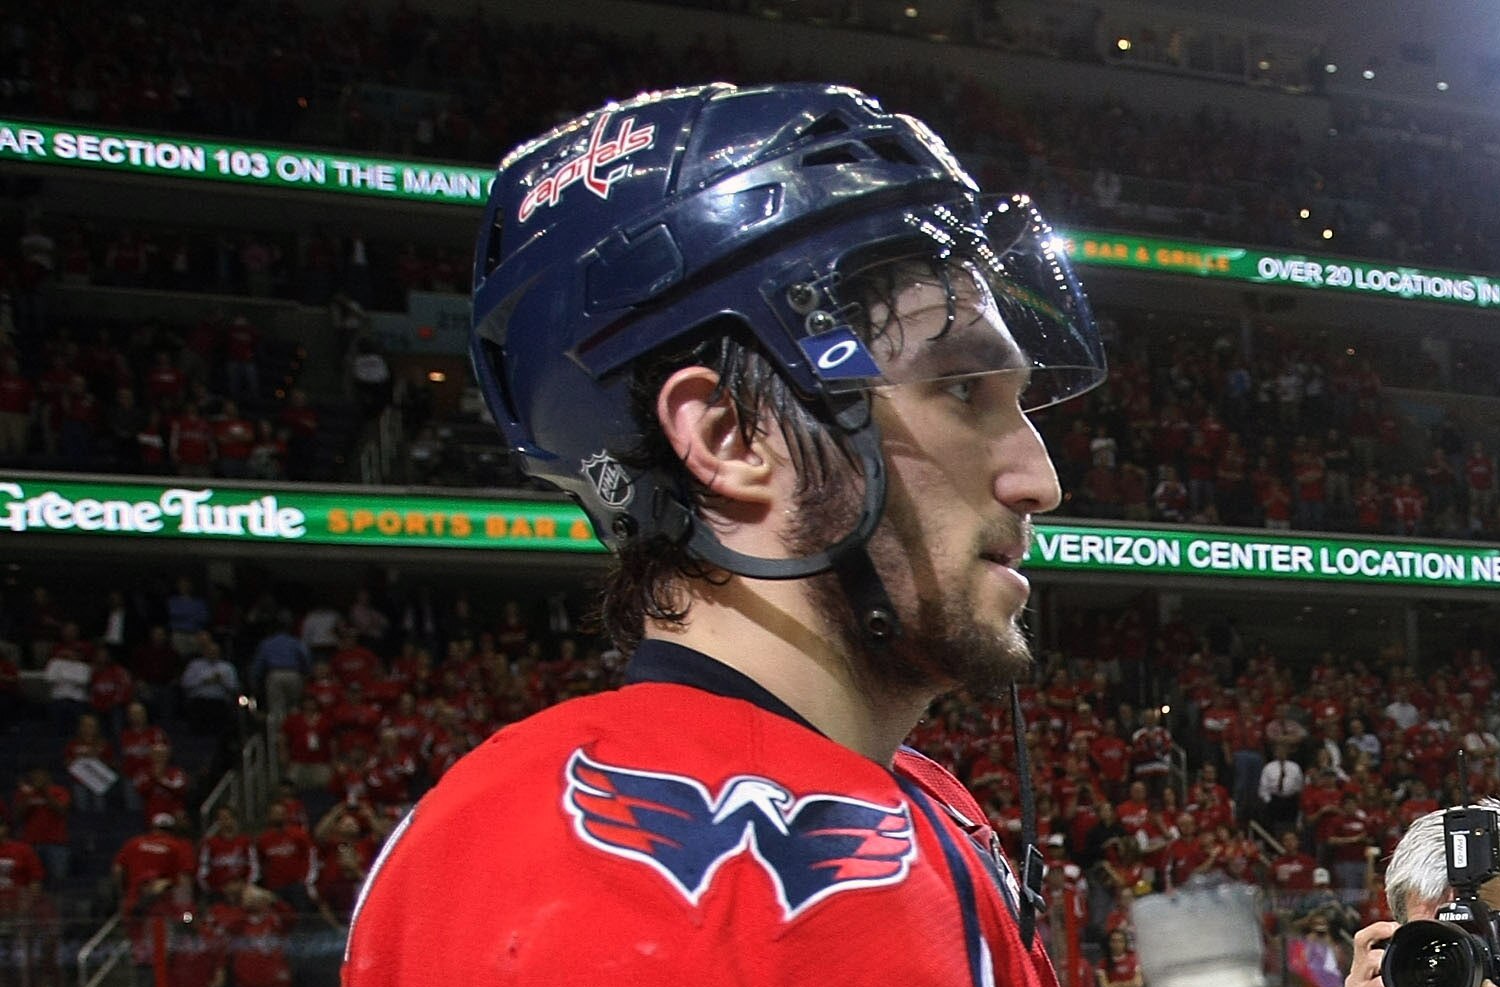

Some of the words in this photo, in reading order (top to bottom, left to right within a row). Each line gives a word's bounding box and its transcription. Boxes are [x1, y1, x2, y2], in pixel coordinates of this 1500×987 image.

[53, 132, 206, 172] SECTION
[214, 149, 270, 178] 103
[276, 155, 325, 184] ON
[331, 161, 397, 191] THE
[403, 168, 481, 199] MAIN
[518, 112, 656, 223] capitals
[1257, 257, 1323, 285] OVER
[1325, 264, 1353, 287] 20
[1353, 268, 1476, 302] LOCATIONS
[1479, 283, 1500, 303] IN
[160, 488, 307, 538] Turtle
[327, 508, 471, 538] SPORTS
[485, 515, 556, 540] BAR
[1036, 533, 1181, 567] VERIZON
[1187, 541, 1315, 573] CENTER
[1320, 548, 1465, 581] LOCATION
[1439, 912, 1469, 921] Nikon
